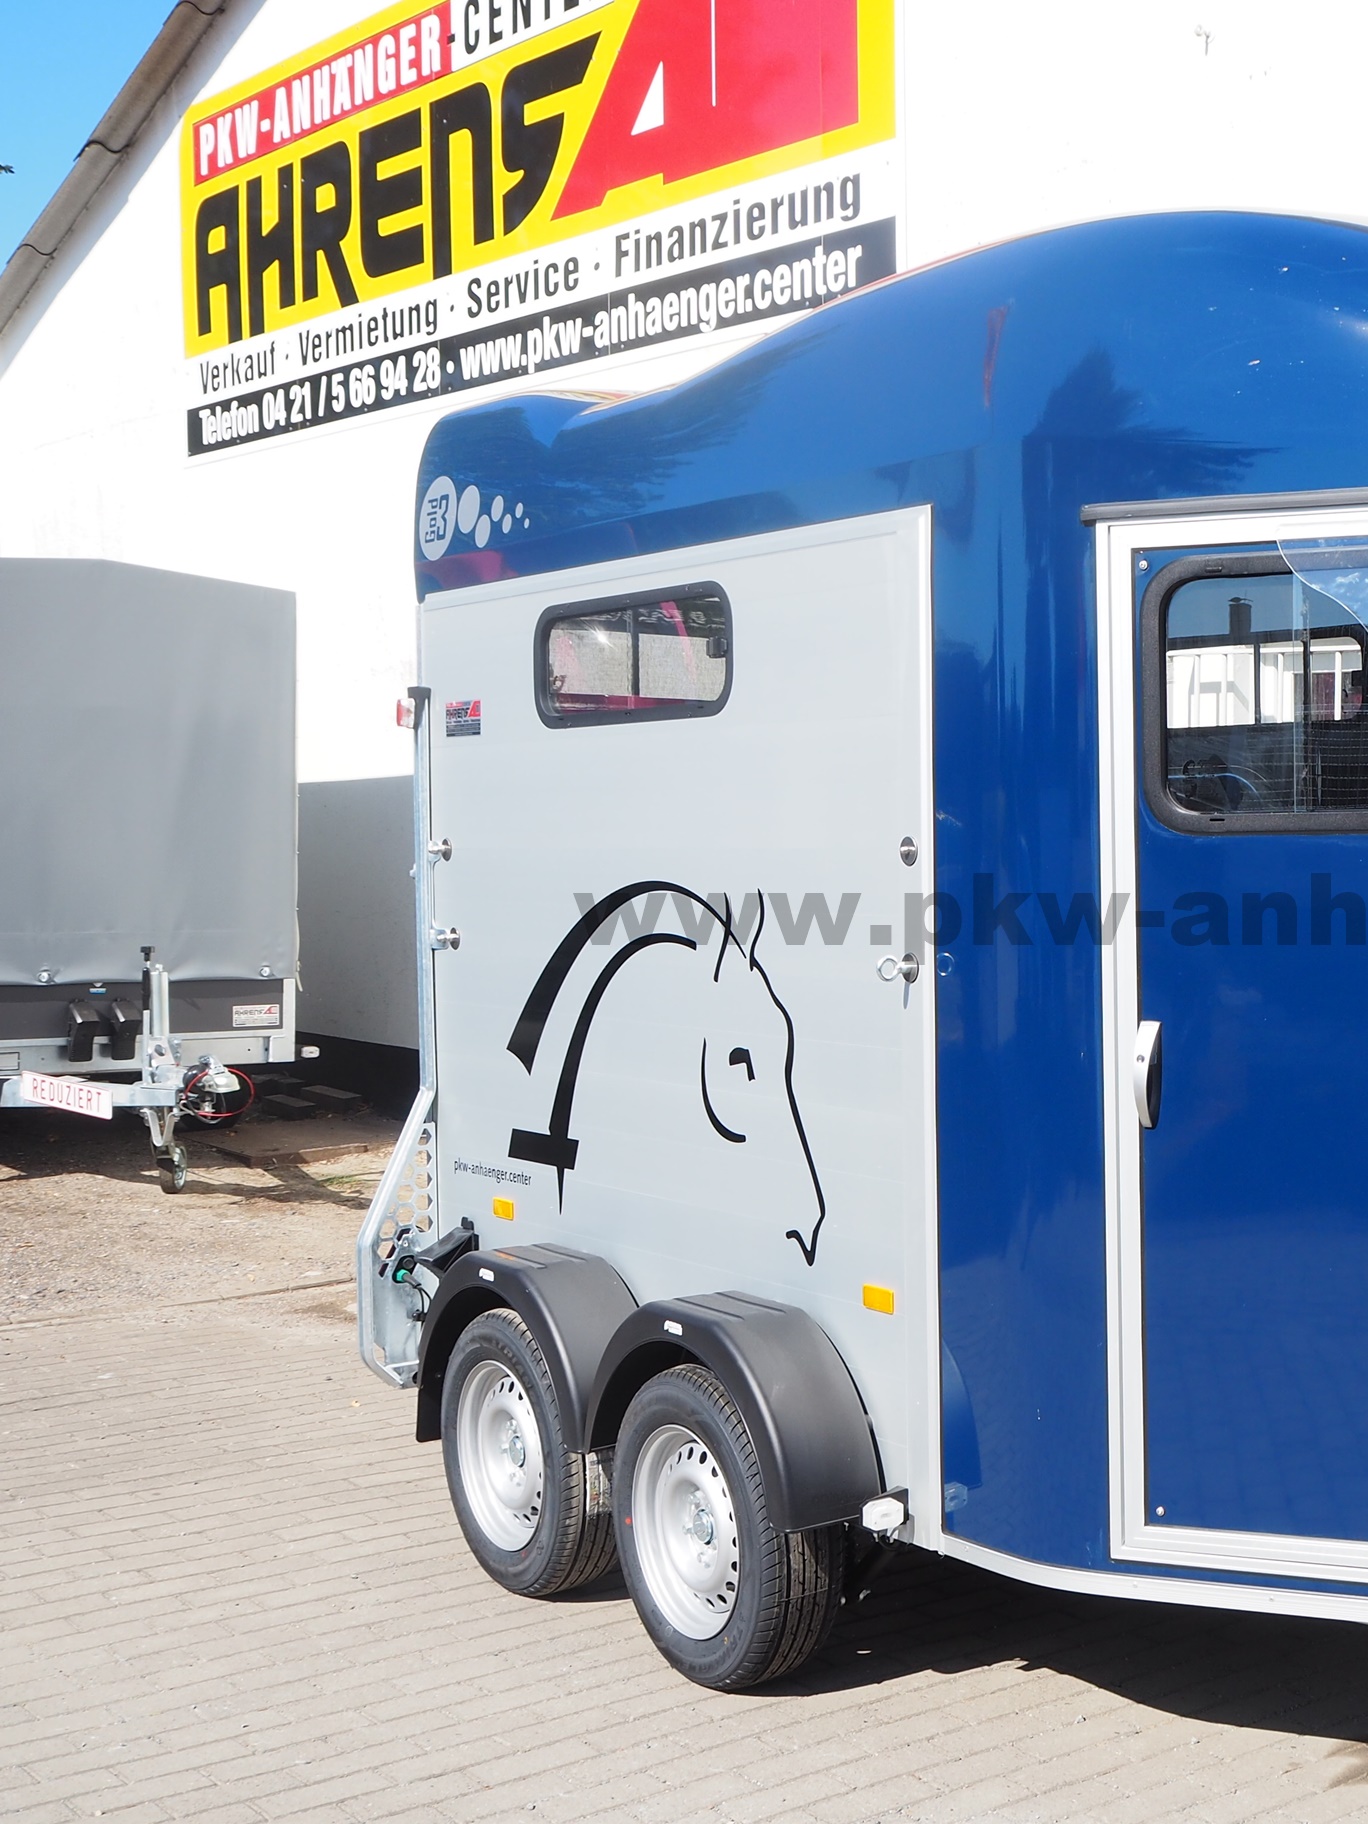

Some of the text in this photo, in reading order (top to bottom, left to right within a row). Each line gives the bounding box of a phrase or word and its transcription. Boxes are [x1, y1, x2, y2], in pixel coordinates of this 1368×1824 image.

[197, 31, 603, 343] AHRENS
[198, 400, 260, 446] Telefon
[262, 388, 287, 430] 04
[289, 381, 312, 424] 21
[331, 373, 345, 413] 5
[348, 364, 376, 408] 66
[379, 355, 408, 400] 94
[412, 346, 441, 393] 28
[459, 243, 863, 381] www.pkw-anhaenger.center
[199, 171, 863, 395] Verkauf Vermietung Service Finanzierung
[425, 498, 438, 544] Gold
[32, 1078, 102, 1113] REDUZIERT
[453, 1157, 532, 1186] pkw-anhaenger.center
